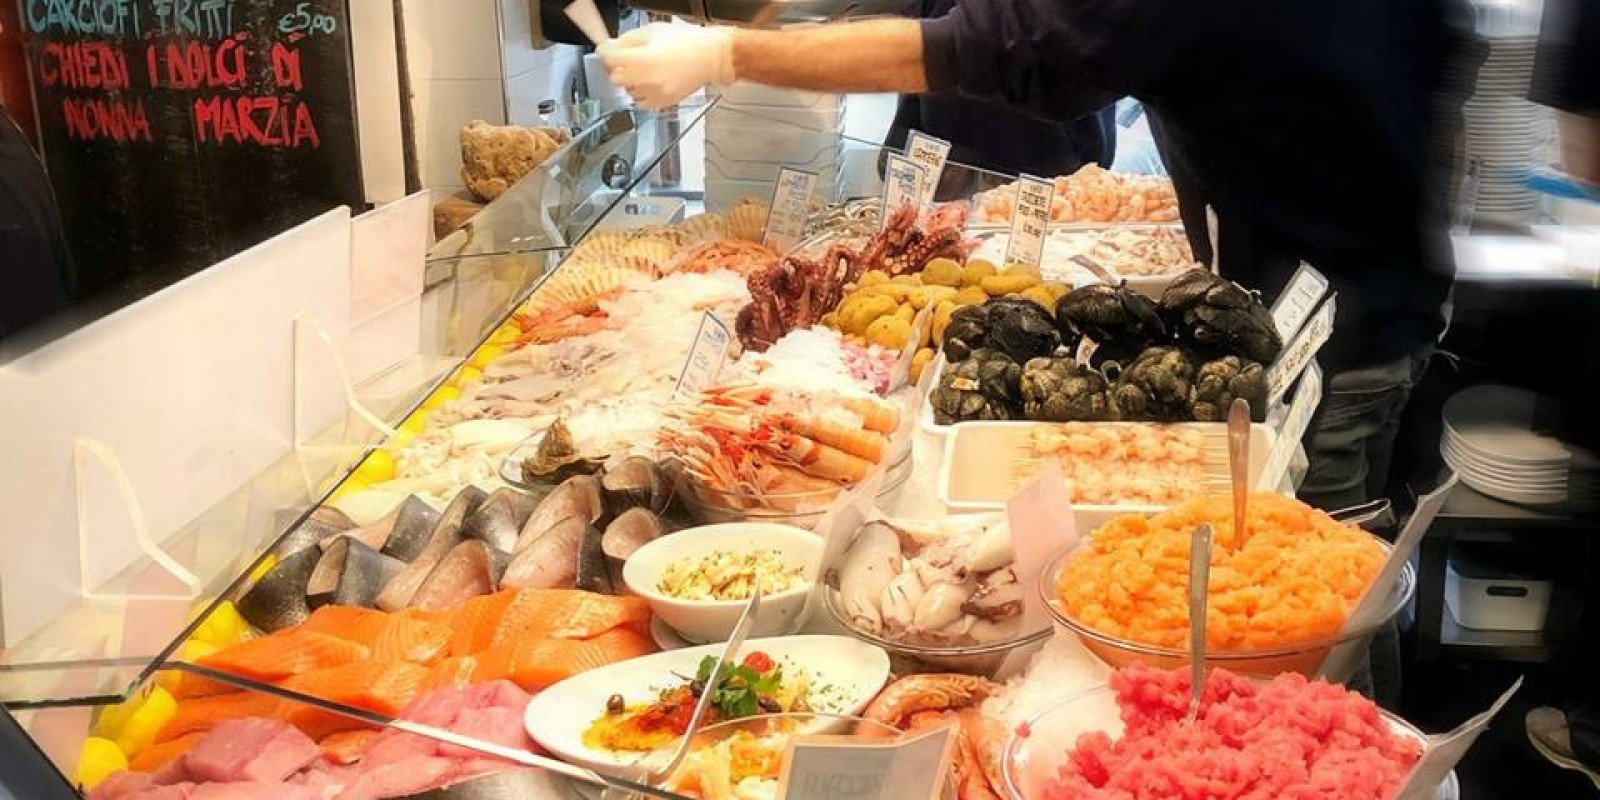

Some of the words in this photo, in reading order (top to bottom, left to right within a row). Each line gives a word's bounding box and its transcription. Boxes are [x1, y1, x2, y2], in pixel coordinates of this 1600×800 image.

[27, 0, 140, 39] CARCIOFI
[40, 43, 130, 90] CHIEDI
[63, 98, 153, 142] NONNA
[194, 98, 320, 147] MARZIA
